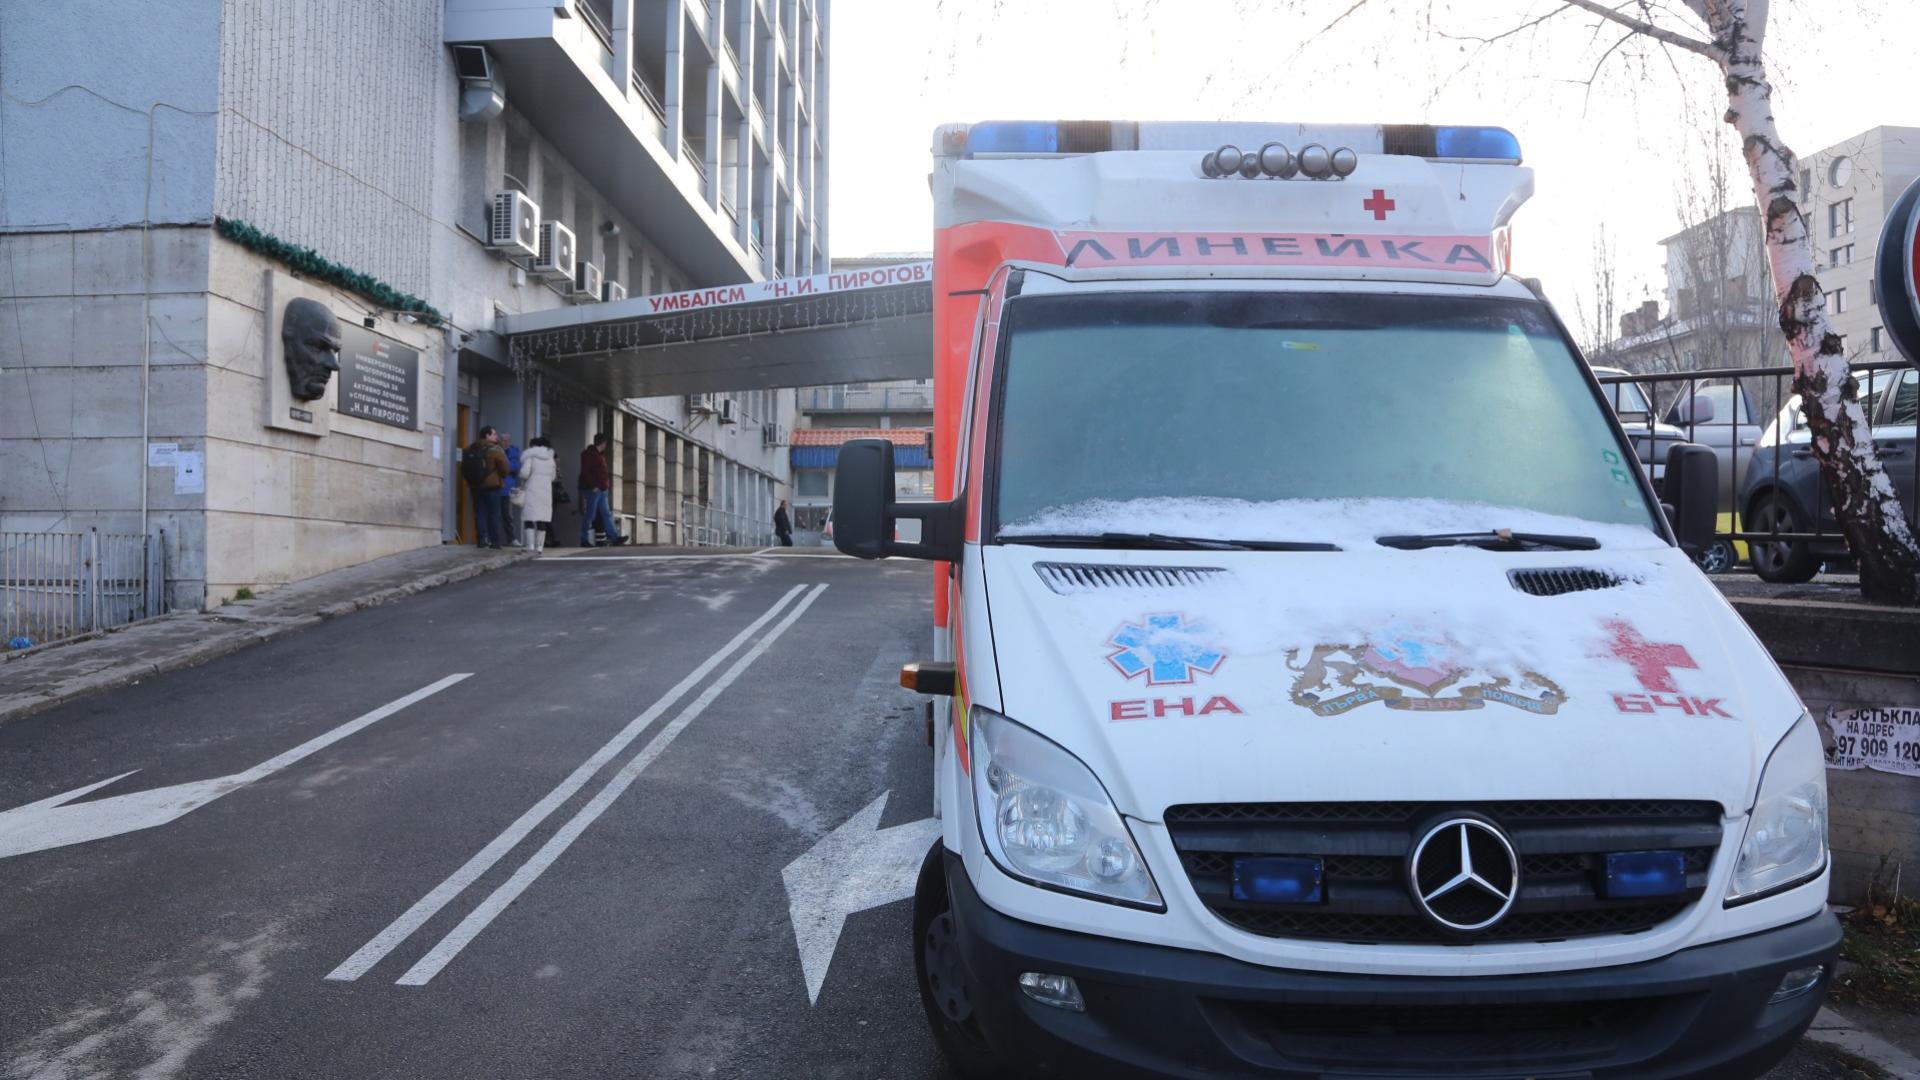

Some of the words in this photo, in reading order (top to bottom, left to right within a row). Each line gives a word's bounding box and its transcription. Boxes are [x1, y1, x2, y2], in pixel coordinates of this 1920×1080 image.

[1066, 233, 1491, 271] ЛИНЕЙКА
[649, 288, 745, 312] УМБАЛСМ
[353, 382, 381, 395] АКТИВНО
[363, 375, 390, 388] БОЛНИЦА
[1111, 696, 1243, 720] ЕНА
[1322, 689, 1377, 713] ПЪРВА
[1483, 687, 1542, 713] ПОМОЩ
[1612, 694, 1735, 718] БЧК
[1847, 721, 1859, 734] НА
[1862, 722, 1894, 738] АДРЕС
[1860, 737, 1888, 758] 909
[1894, 741, 1920, 762] 120
